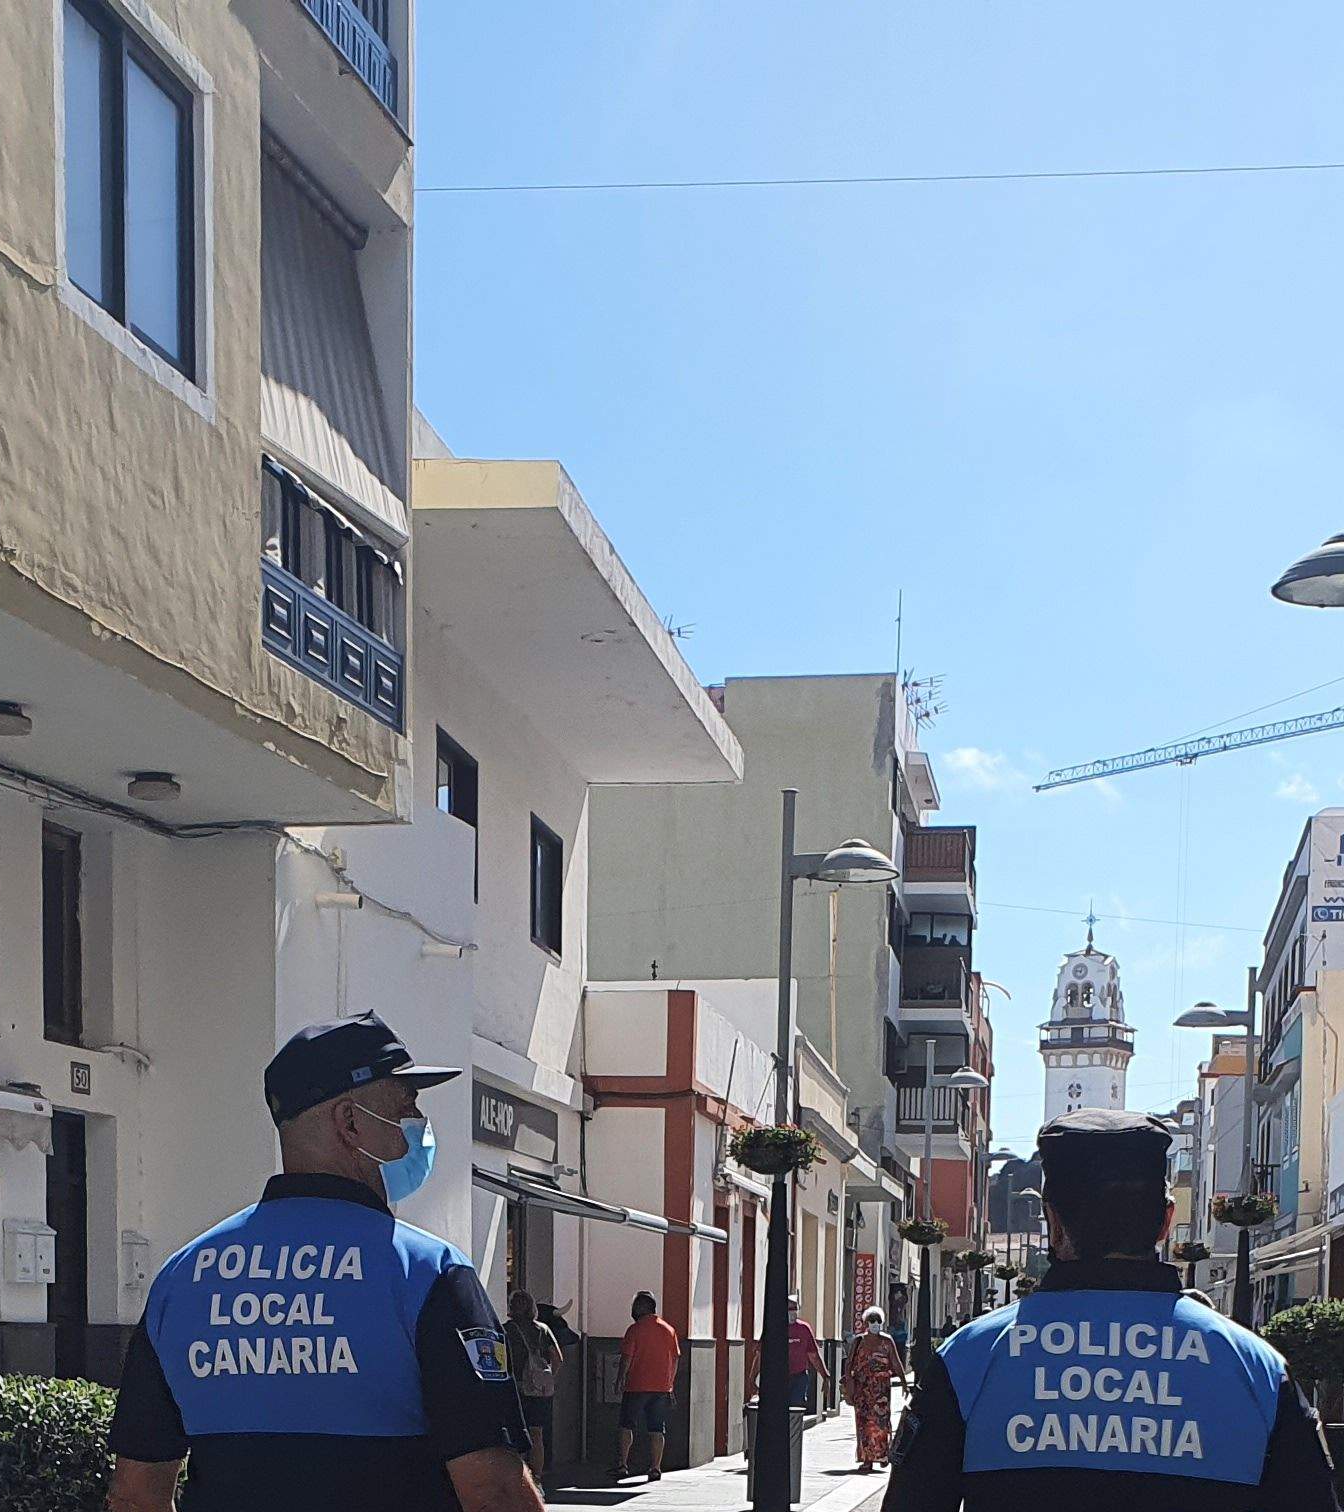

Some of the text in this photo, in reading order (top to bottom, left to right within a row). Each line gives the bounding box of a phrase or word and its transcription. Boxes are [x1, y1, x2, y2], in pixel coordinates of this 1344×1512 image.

[480, 1094, 514, 1137] ALE-HOP
[192, 1244, 364, 1282] POLICIA
[209, 1292, 335, 1326] LOCAL
[187, 1335, 359, 1378] CANARIA
[1008, 1320, 1211, 1365] POLICIA
[1033, 1366, 1184, 1406] LOCAL
[1006, 1413, 1204, 1460] CANARIA
